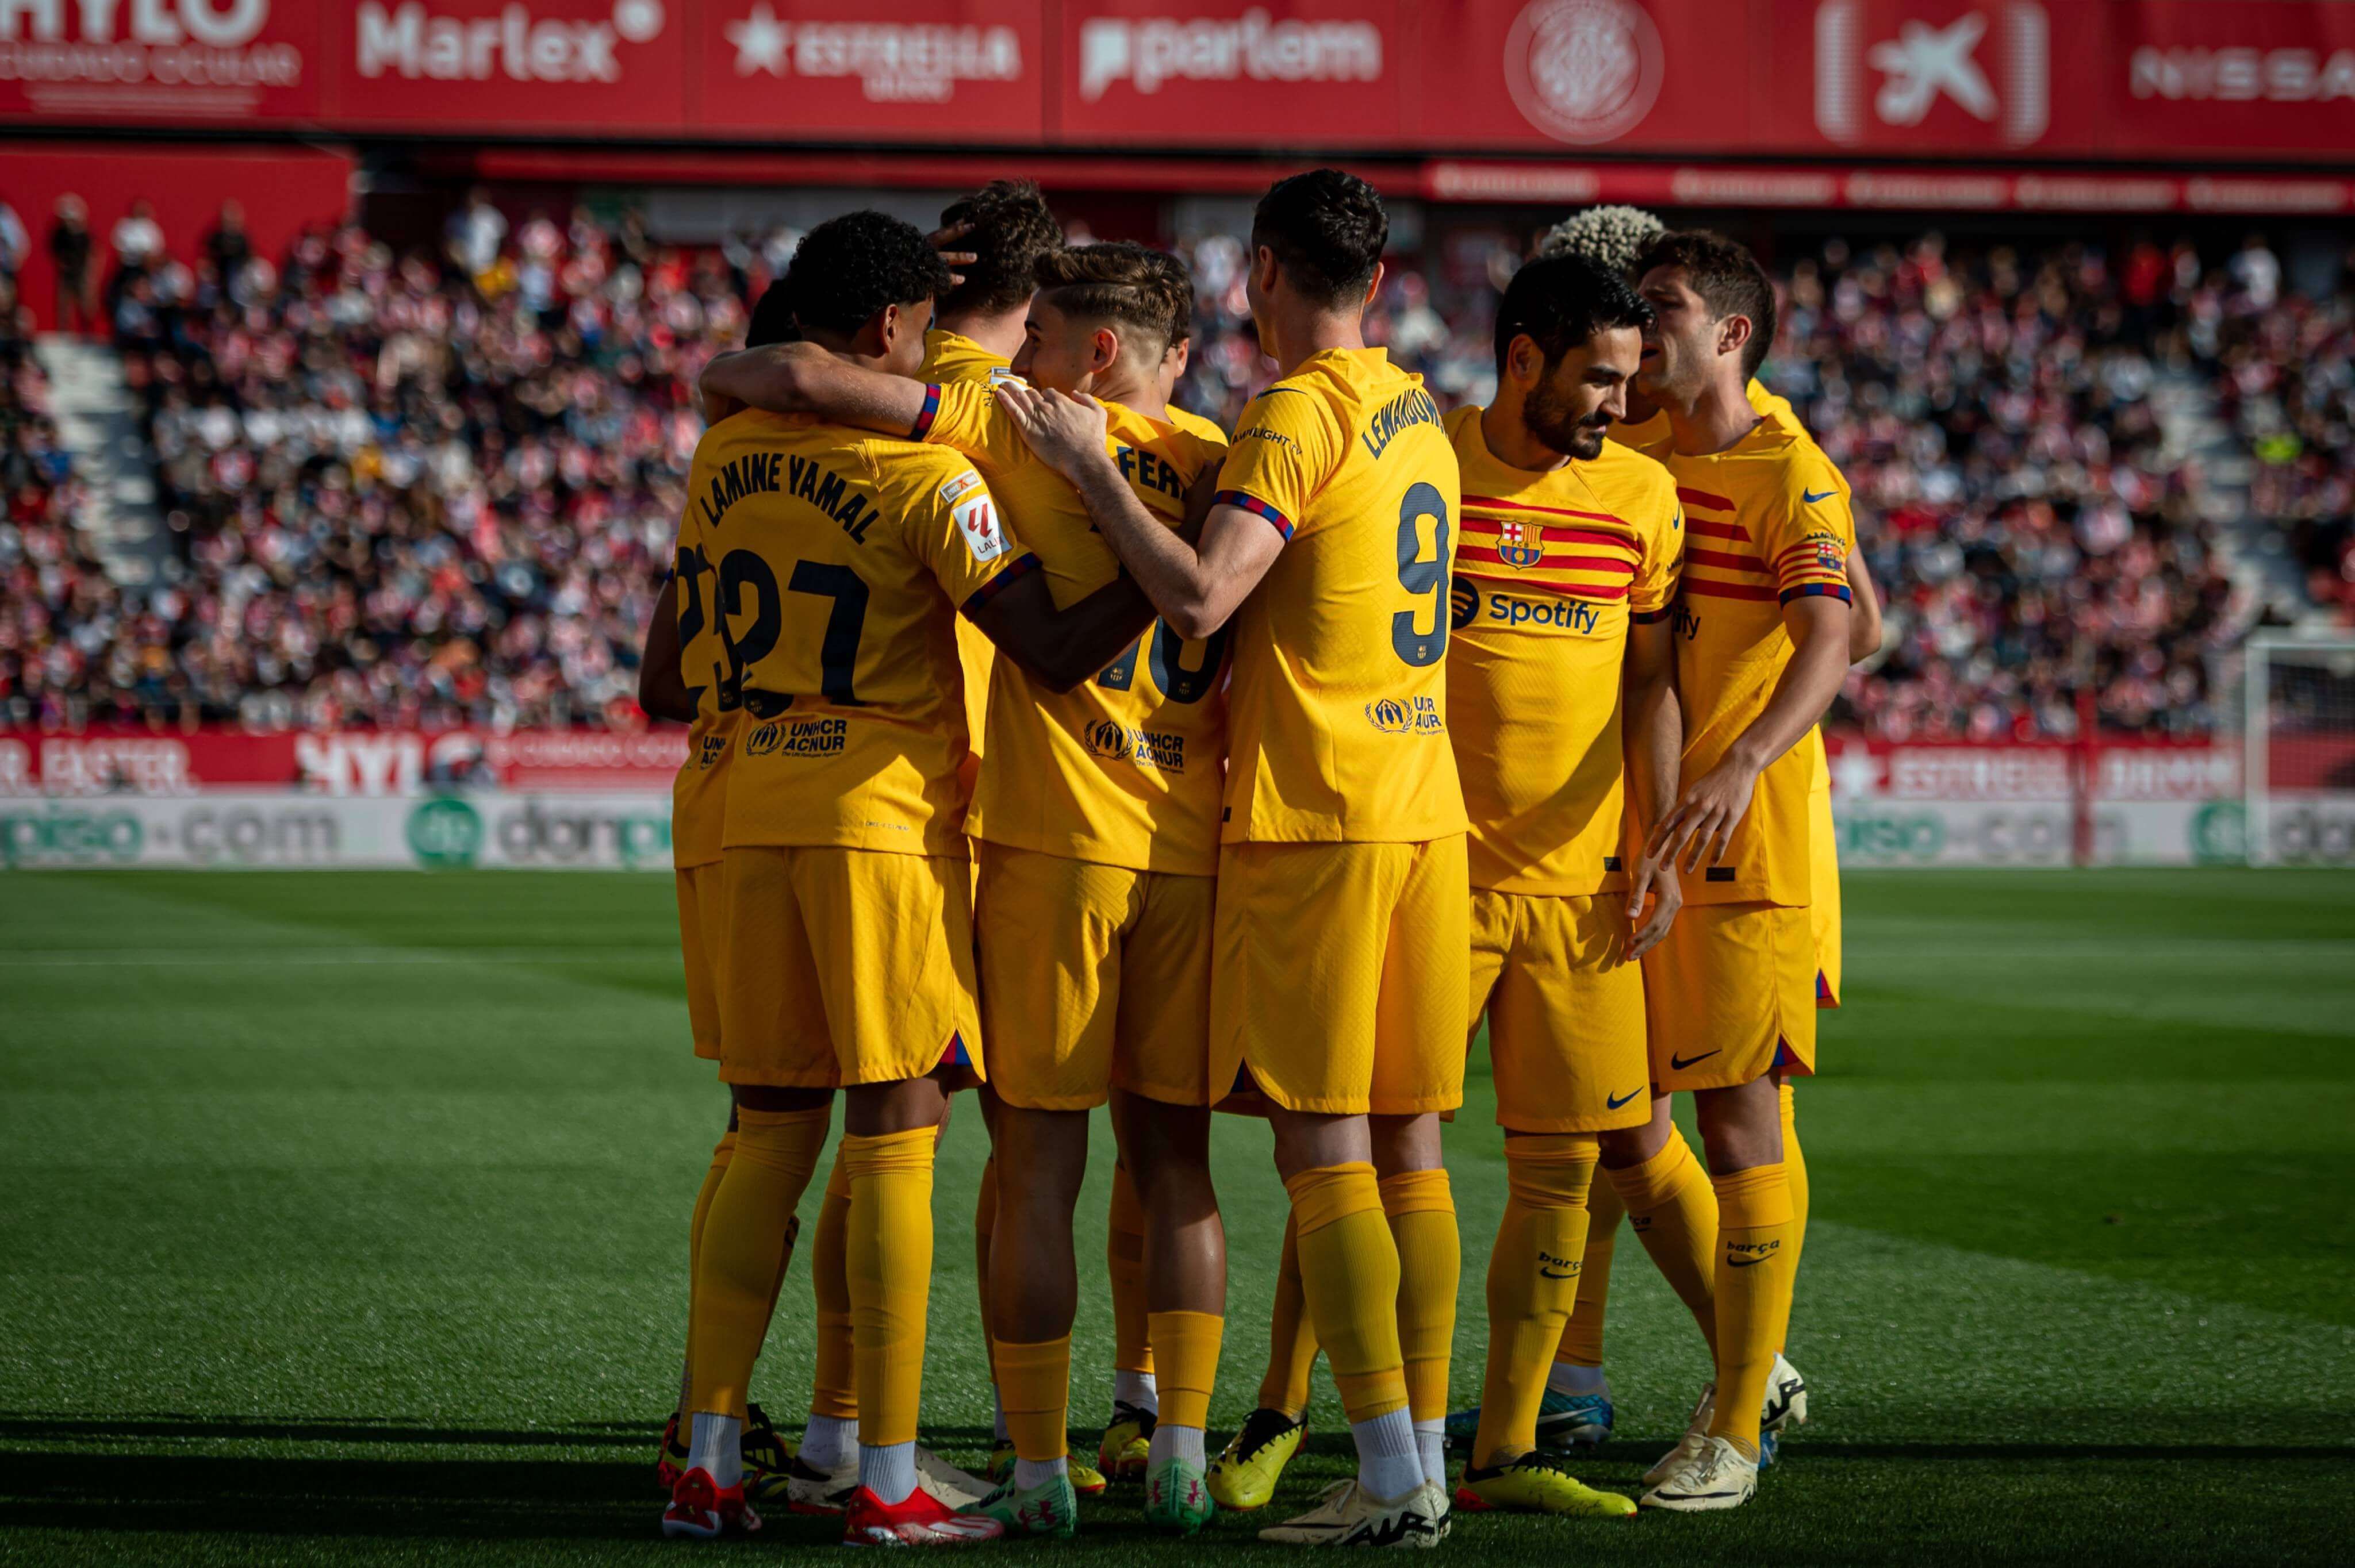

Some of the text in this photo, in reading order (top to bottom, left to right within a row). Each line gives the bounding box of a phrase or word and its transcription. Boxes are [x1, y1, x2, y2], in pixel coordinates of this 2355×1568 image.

[356, 0, 622, 82] Marlex
[1131, 7, 1383, 94] parlem
[1361, 389, 1448, 460] LEWANDOW
[700, 452, 880, 545] LAMINE YAMAL
[1117, 446, 1186, 502] FER
[1393, 482, 1449, 667] 9
[719, 549, 870, 720] 27
[1489, 594, 1600, 635] Spotify
[783, 735, 845, 752] ACNUR
[791, 718, 847, 736] UNHCR
[1133, 729, 1183, 751] UNHCR
[1136, 744, 1183, 767] ACNUR
[1727, 1240, 1779, 1254] barça
